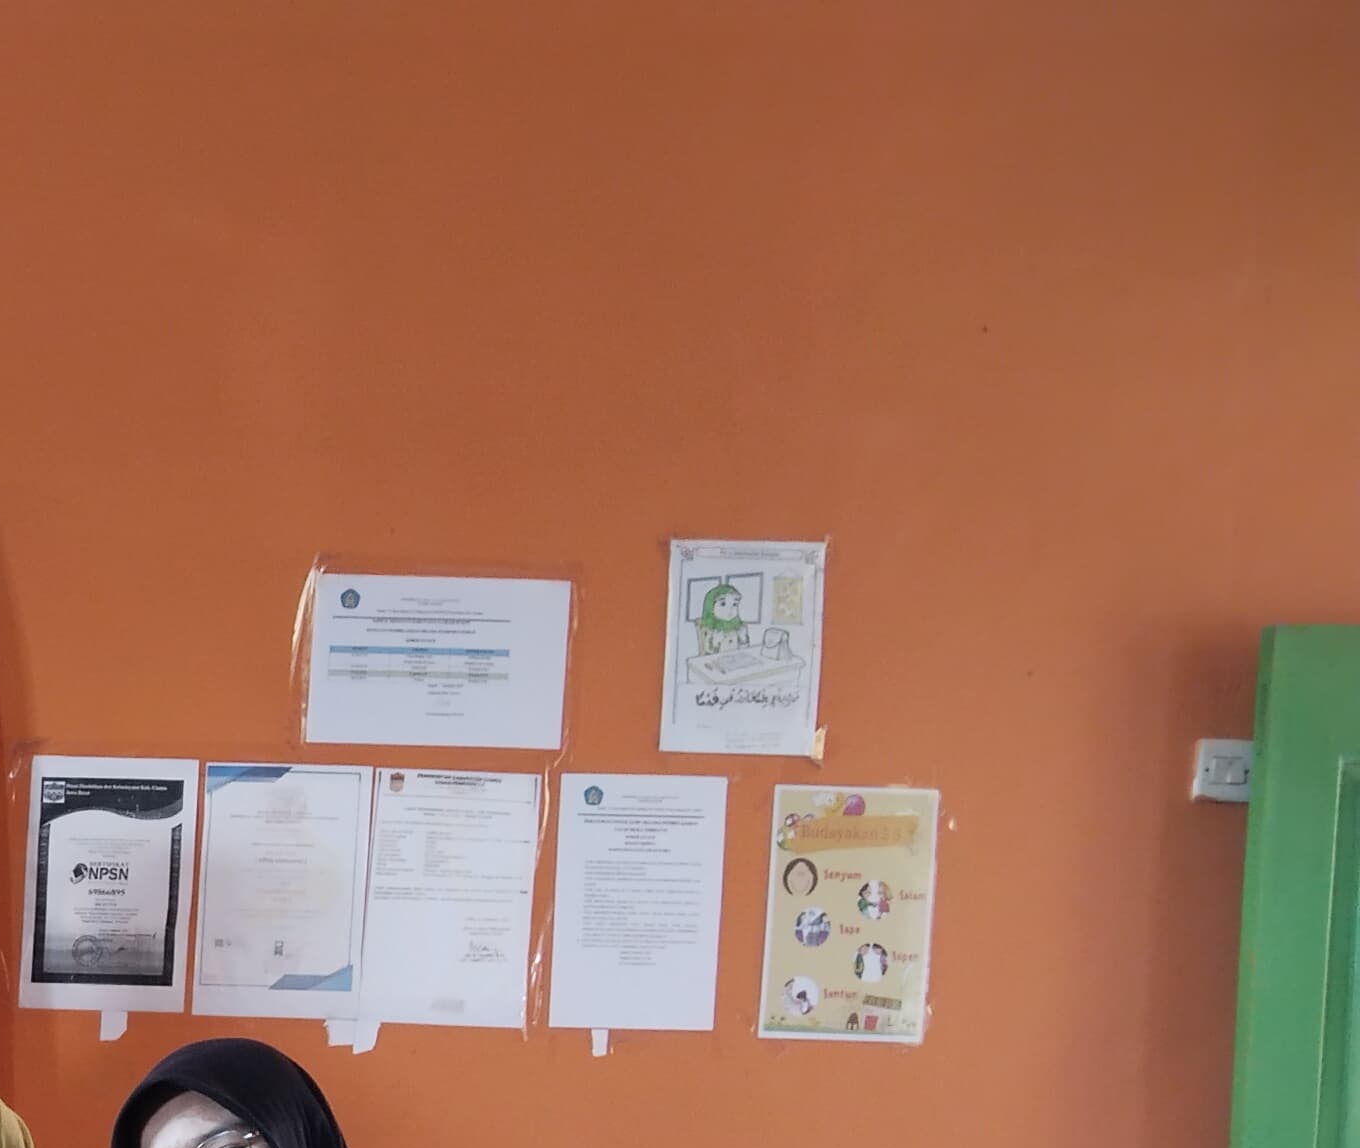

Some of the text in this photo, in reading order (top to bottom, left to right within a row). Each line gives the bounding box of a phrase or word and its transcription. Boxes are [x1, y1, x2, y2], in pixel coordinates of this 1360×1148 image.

[88, 867, 129, 881] NPSN
[823, 868, 863, 883] Senyum
[839, 923, 861, 936] Sapa
